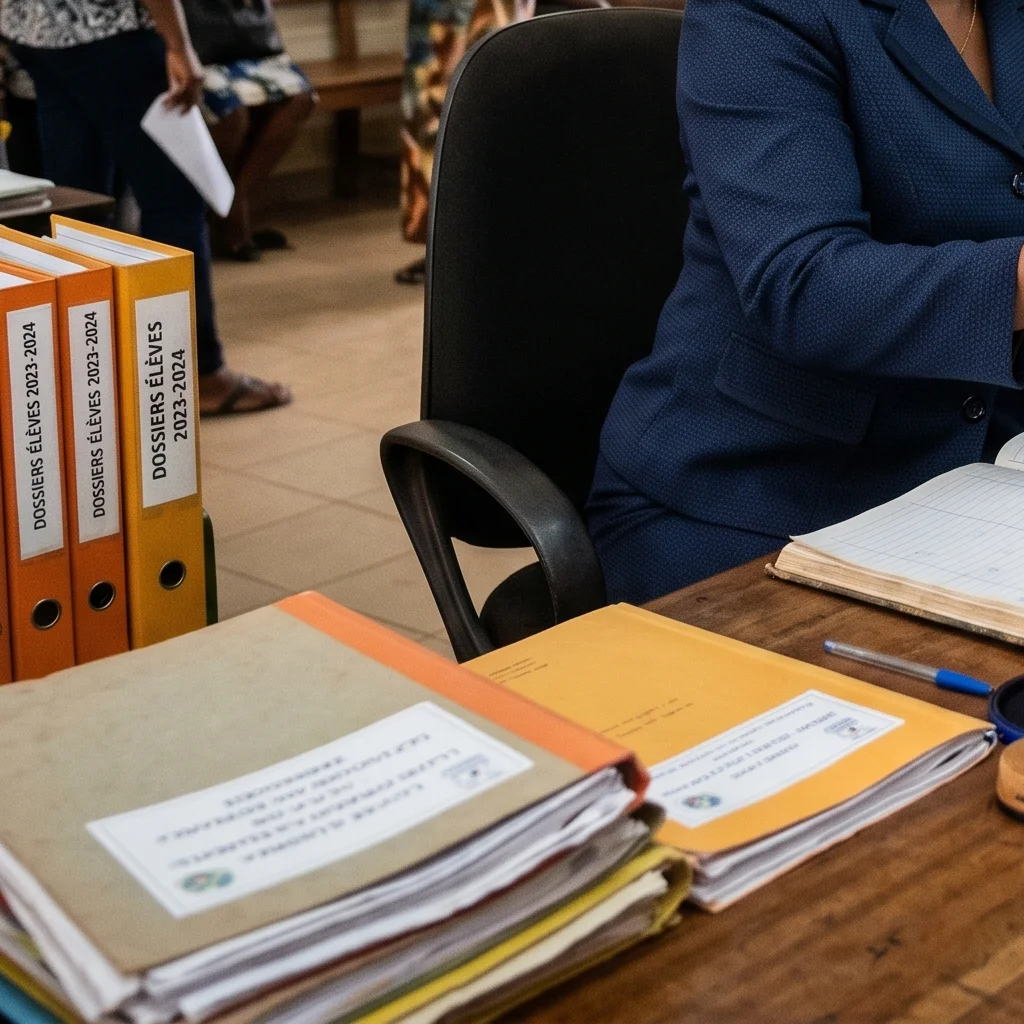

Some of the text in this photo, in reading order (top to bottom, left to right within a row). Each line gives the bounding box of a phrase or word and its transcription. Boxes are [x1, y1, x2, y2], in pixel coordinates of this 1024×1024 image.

[22, 321, 47, 531] DOSSIERS ÉLÈVES 2023-2024
[84, 310, 106, 519] DOSSIERS ÉLÈVES 2023-2024
[145, 320, 167, 481] DOSSIERS ÉLÈVES
[172, 348, 188, 441] 2023-2024
